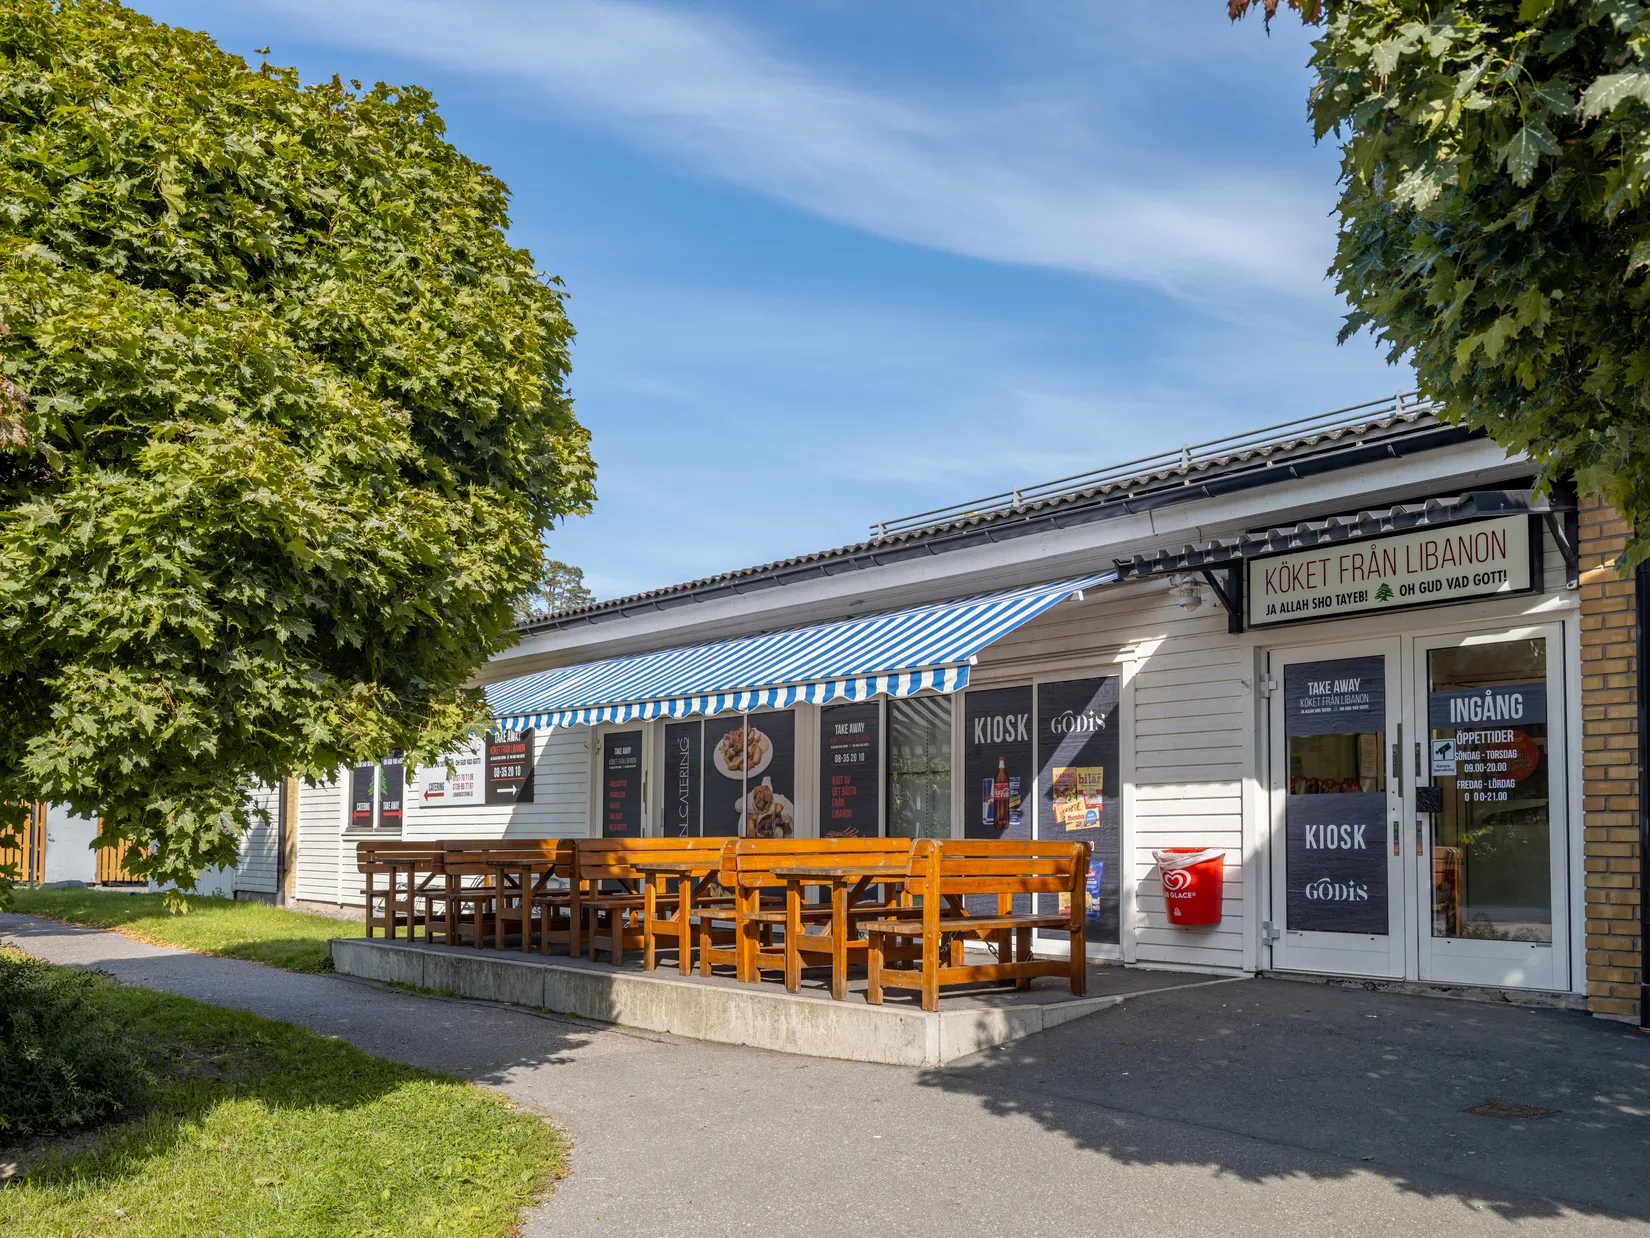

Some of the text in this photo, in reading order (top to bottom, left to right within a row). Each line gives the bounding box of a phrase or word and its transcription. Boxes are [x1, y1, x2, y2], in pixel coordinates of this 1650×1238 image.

[1265, 528, 1507, 596] KÖKET FRÅN LIBANON
[1266, 570, 1508, 616] JA ALLAH SHO TAYEB! OH GUD VAD GOTT!
[1308, 678, 1360, 694] TAKE AWAY
[1300, 694, 1368, 708] KÖKET FRÅN LIBANON
[1450, 689, 1523, 723] INGÅNG
[834, 722, 864, 734] TAKE AWAY
[974, 713, 1029, 745] KIOSK
[496, 730, 506, 744] TAKE
[1456, 730, 1514, 744] ÖPPETTIDER
[834, 752, 864, 762] 08-35 20 10
[1454, 752, 1480, 760] SÖNDAG
[1486, 750, 1518, 758] TORSDAG
[494, 766, 522, 778] 08-35 20 10
[1464, 762, 1506, 772] 09.00-20.00
[678, 737, 689, 818] CATERING
[1078, 774, 1100, 784] bilar
[1456, 780, 1482, 790] FREDAG
[1488, 778, 1516, 788] LÖRDAG
[428, 782, 444, 790] CATERING
[356, 802, 370, 810] CATERING
[392, 802, 400, 810] AWAY
[1305, 824, 1366, 850] KIOSK
